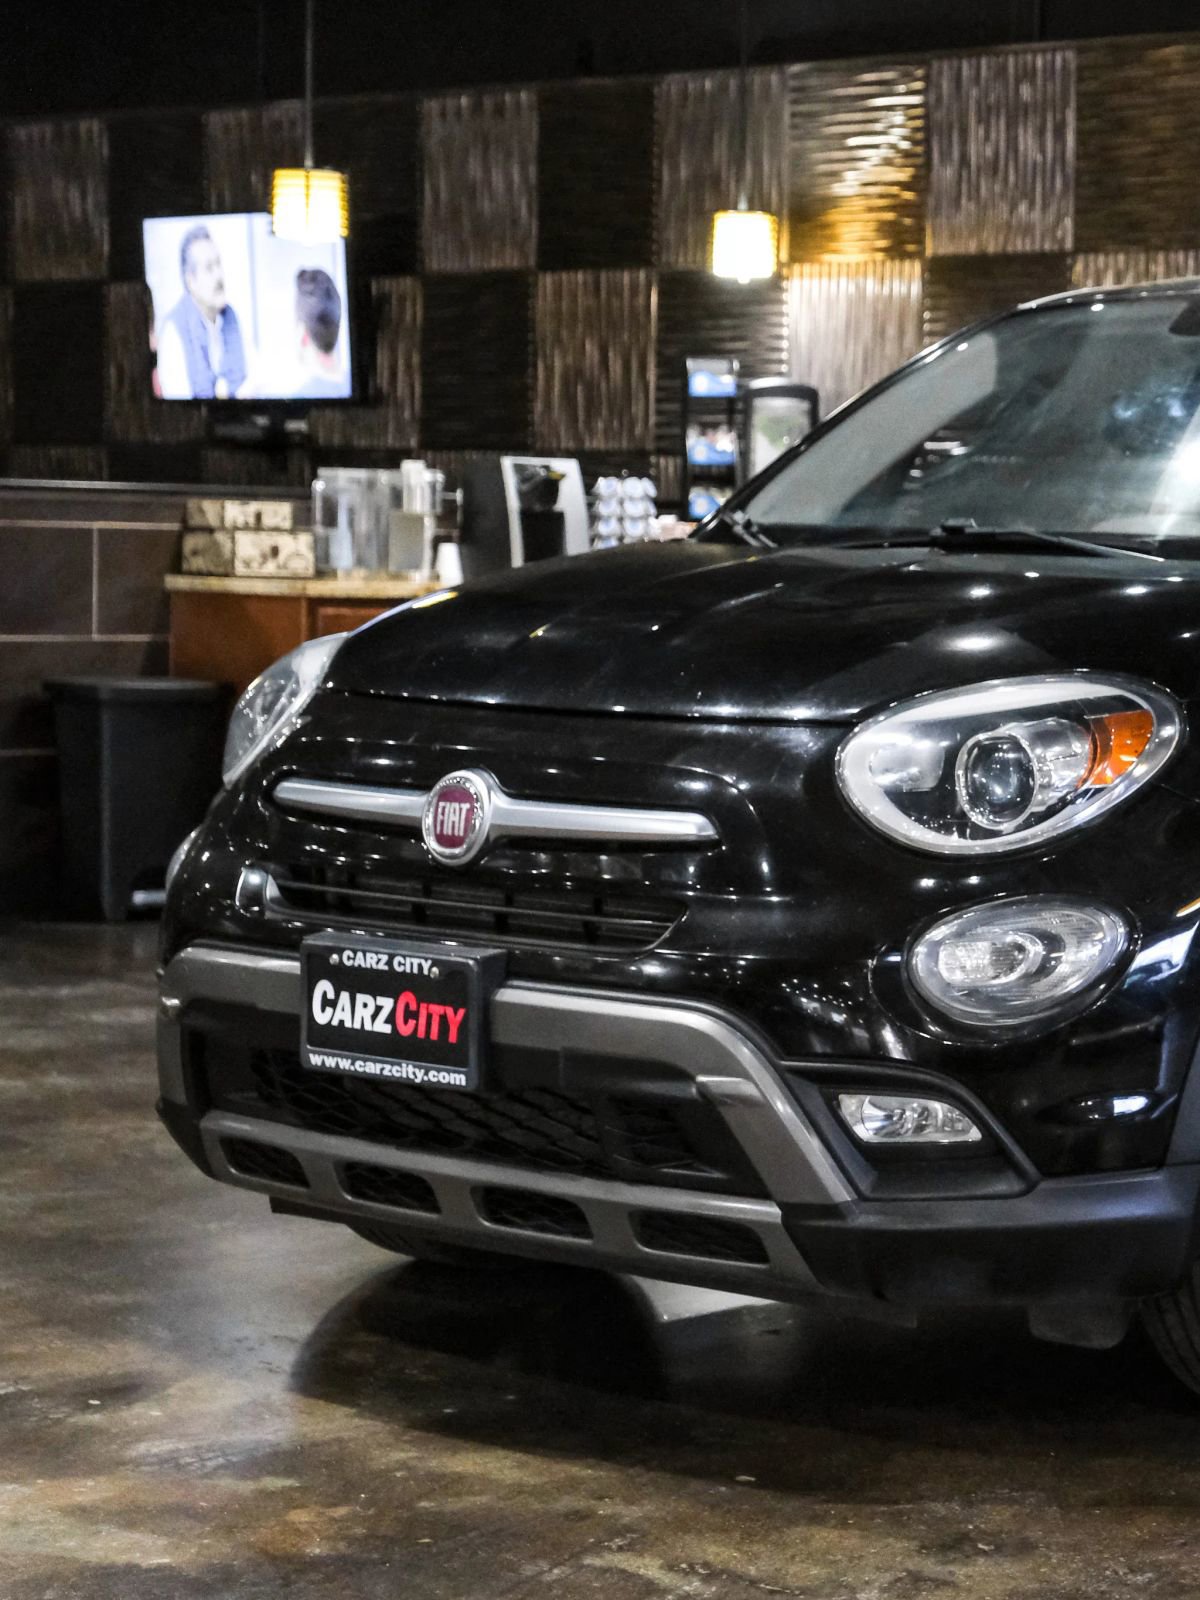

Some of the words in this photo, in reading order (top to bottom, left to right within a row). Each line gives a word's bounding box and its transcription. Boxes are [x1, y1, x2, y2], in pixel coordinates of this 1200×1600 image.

[436, 801, 471, 836] FIAT
[342, 950, 389, 971] CARZ
[393, 956, 432, 975] CITY
[309, 1052, 467, 1086] www.carzcity.com
